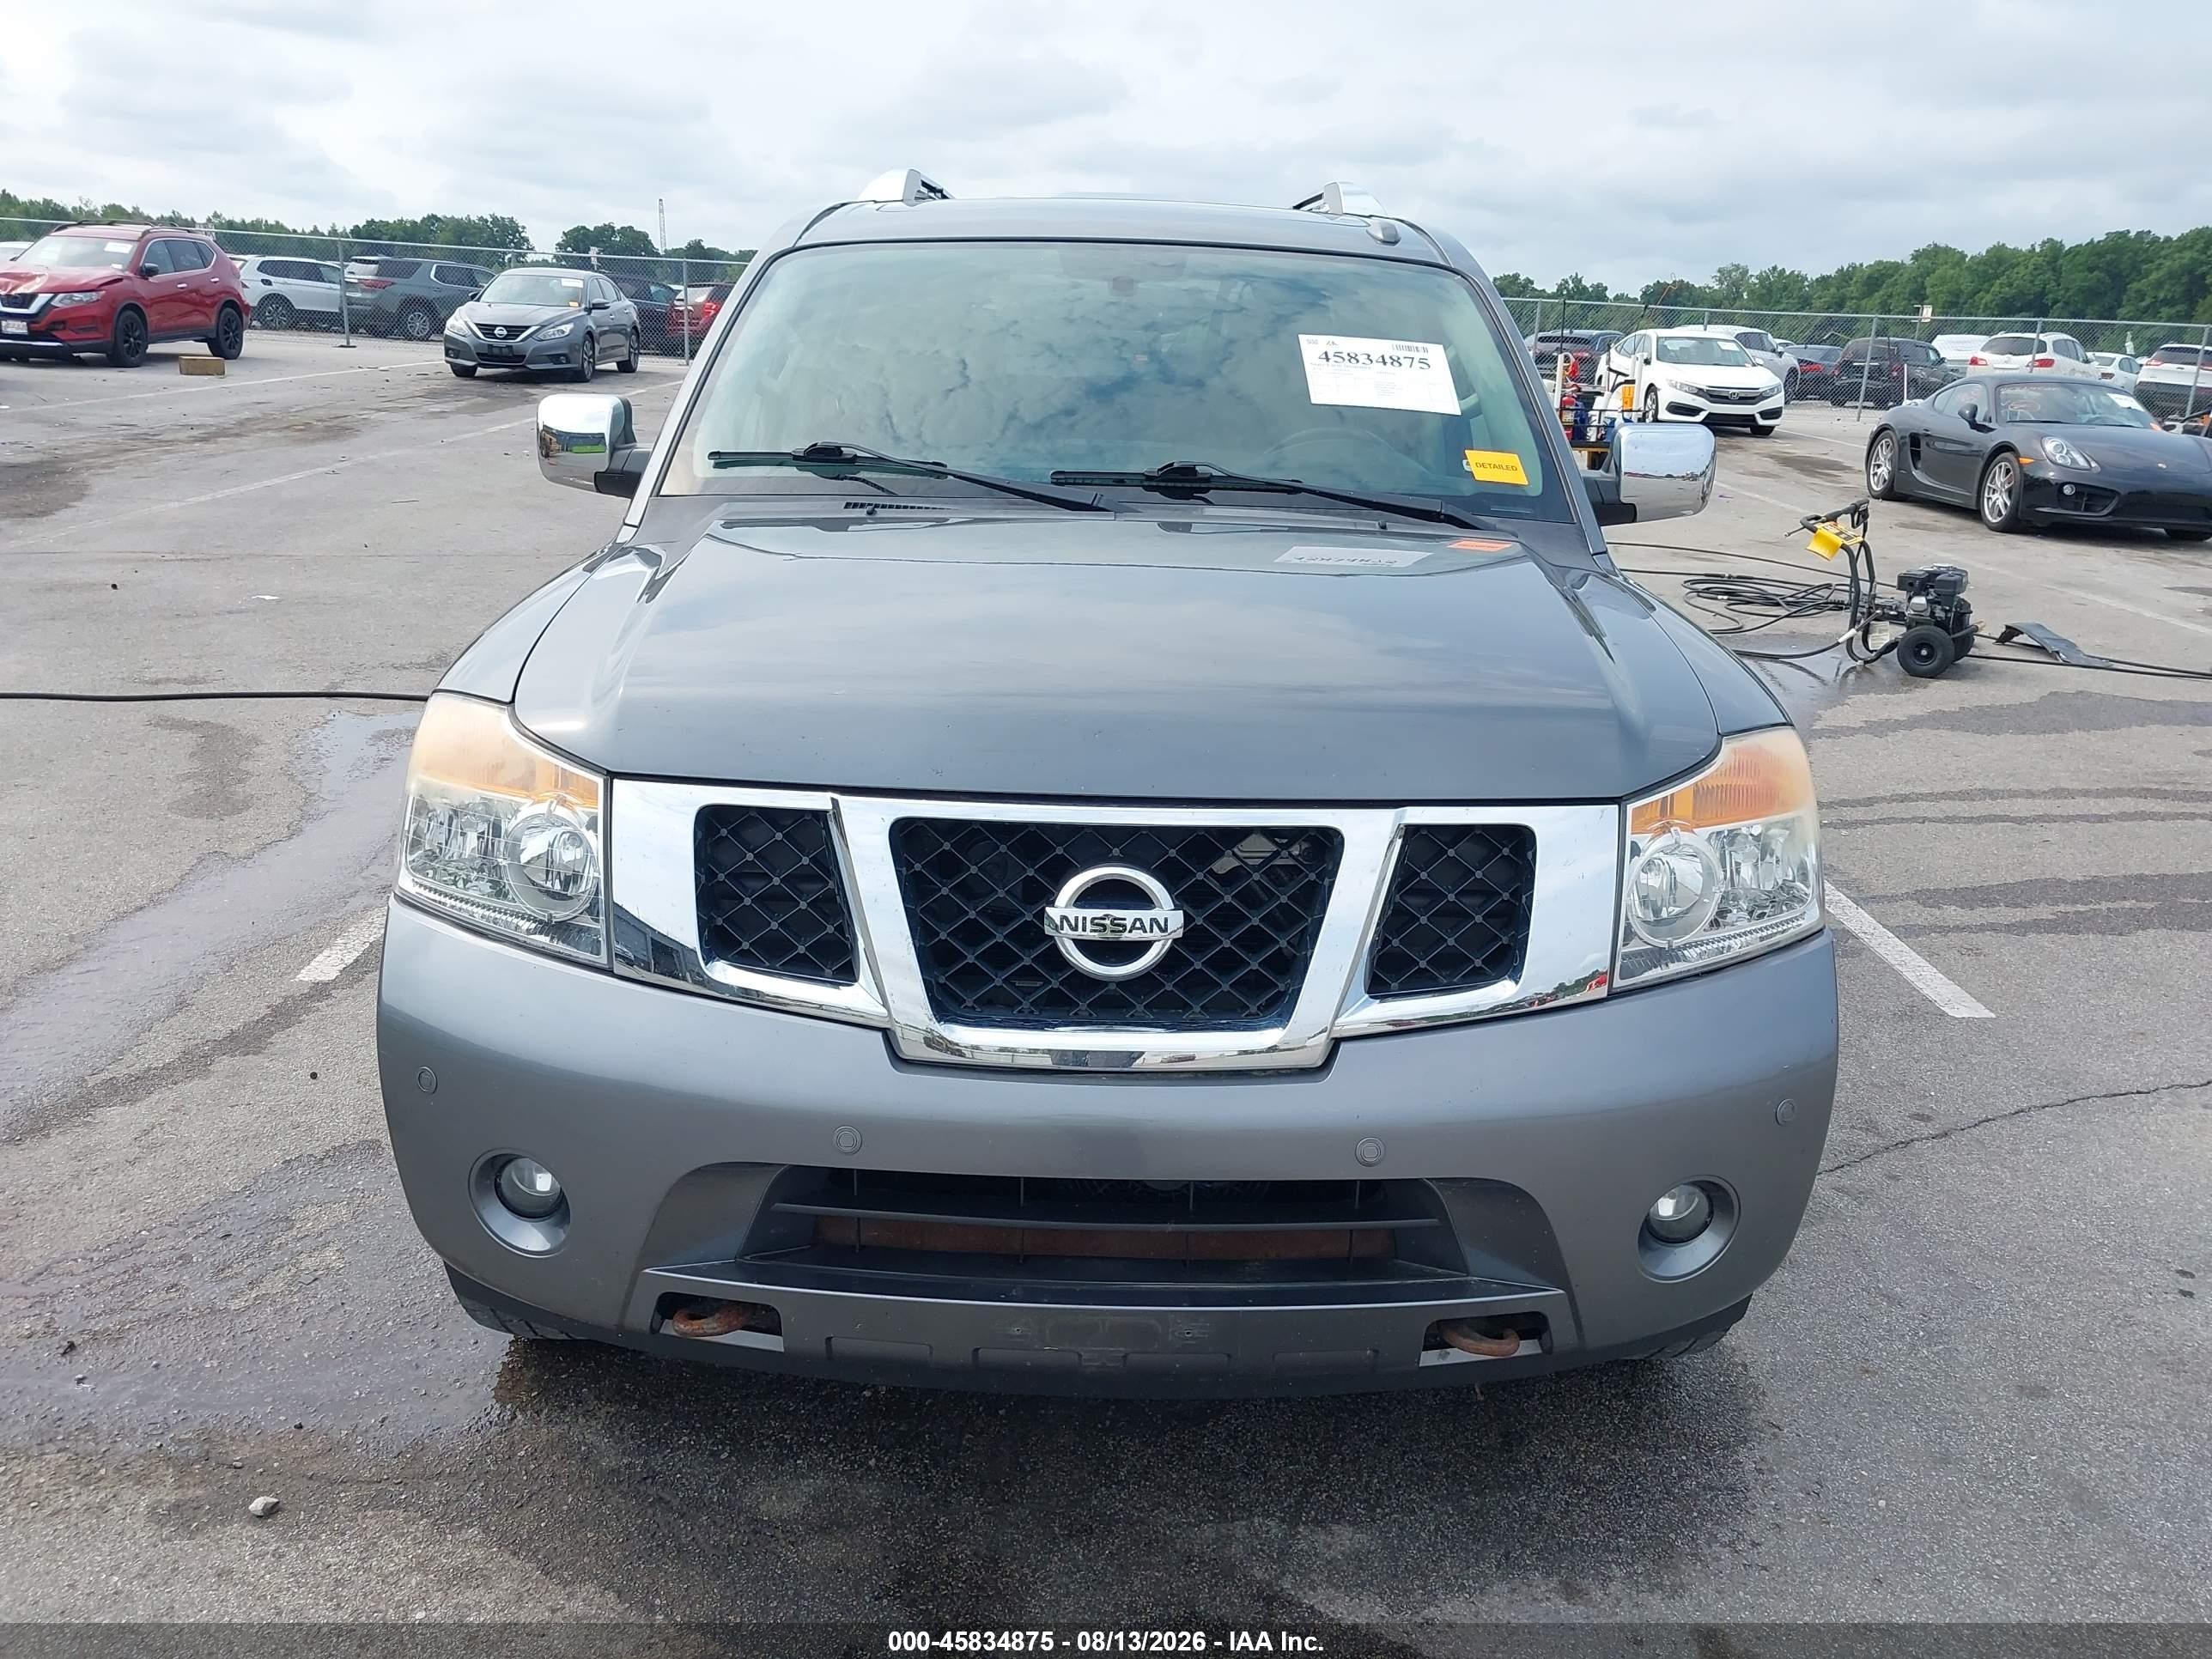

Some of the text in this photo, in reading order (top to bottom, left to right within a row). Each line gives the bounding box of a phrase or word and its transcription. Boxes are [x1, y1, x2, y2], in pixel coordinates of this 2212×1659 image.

[1318, 349, 1431, 370] 45834875
[1475, 462, 1518, 471] DETAILED
[1059, 915, 1169, 934] NISSAN
